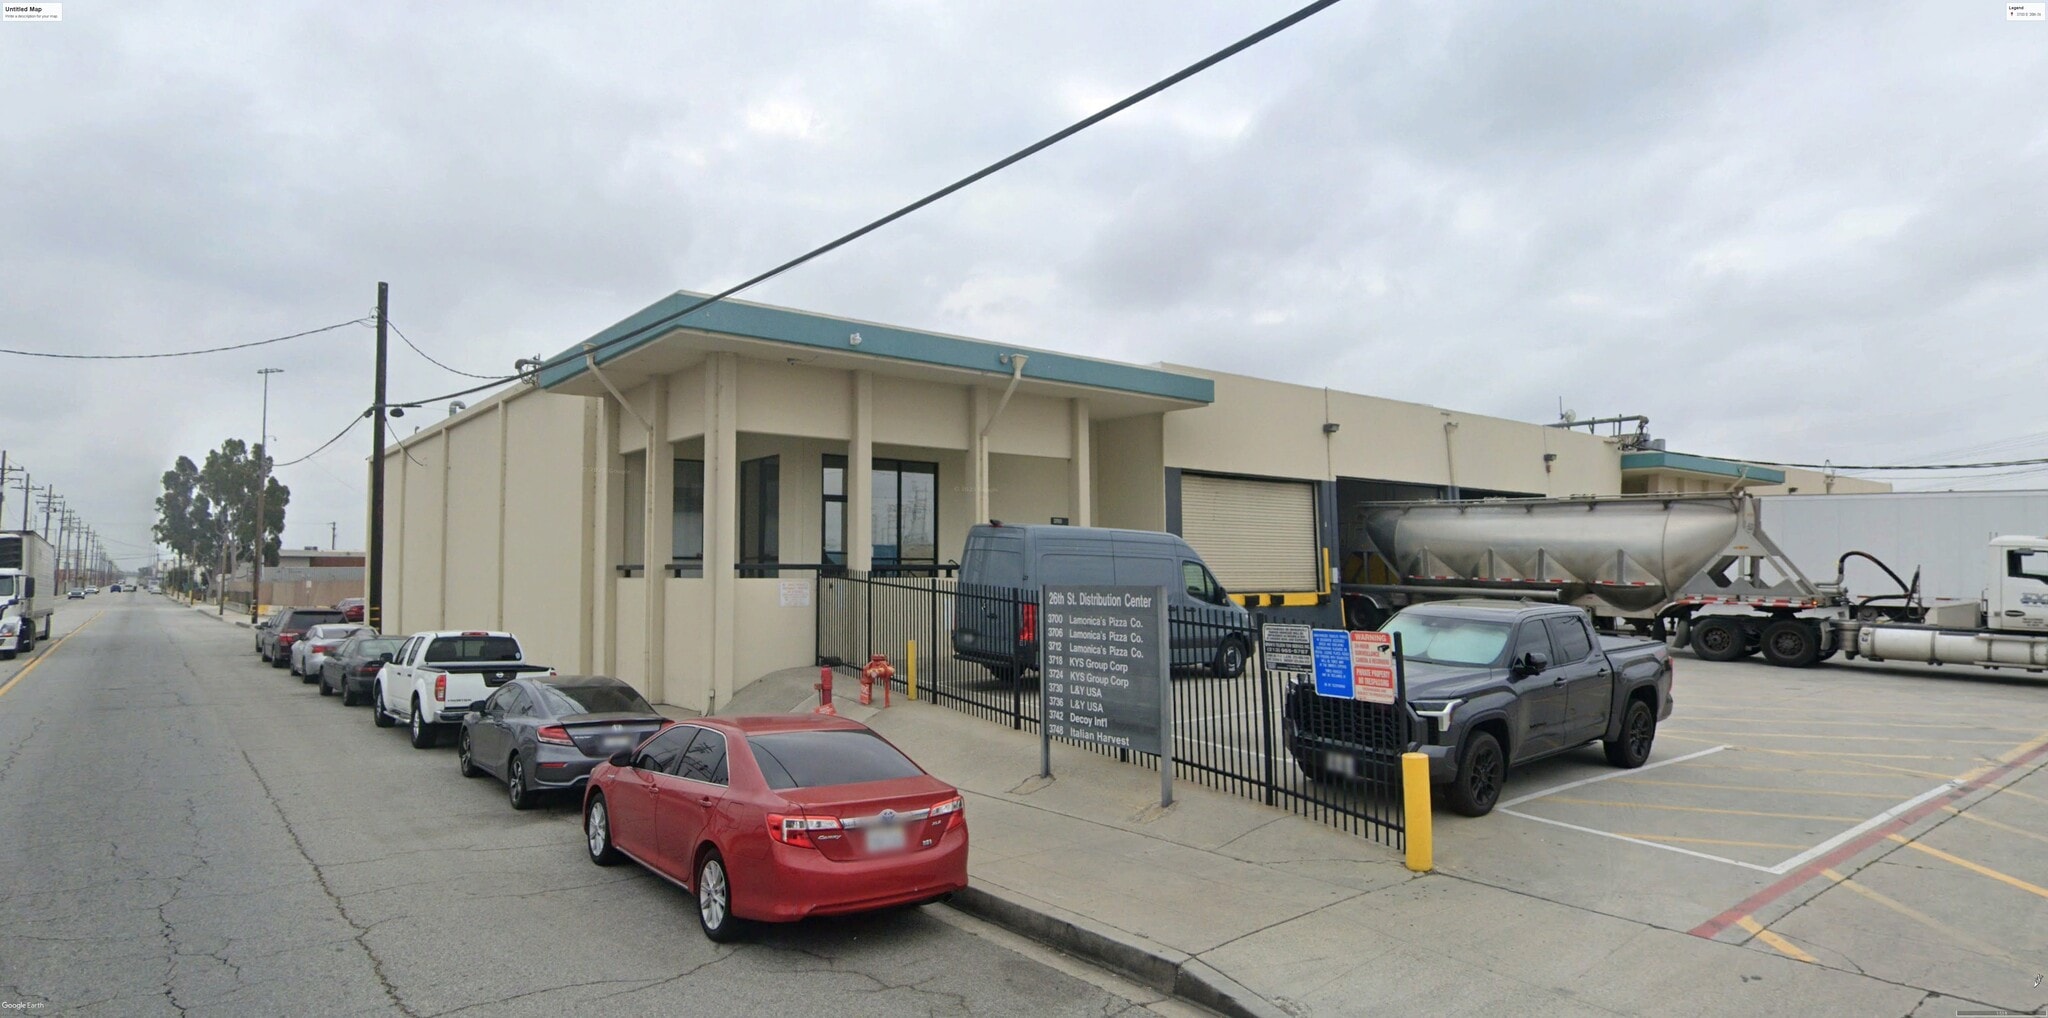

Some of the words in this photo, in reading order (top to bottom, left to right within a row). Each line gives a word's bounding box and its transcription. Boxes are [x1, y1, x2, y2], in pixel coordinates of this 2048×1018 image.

[1048, 592, 1064, 605] 26th
[1067, 592, 1077, 605] St.
[1080, 592, 1121, 607] Distribution
[1124, 594, 1152, 608] Center
[1048, 614, 1063, 624] 3700
[1069, 615, 1106, 626] Lamonica's
[1109, 617, 1127, 627] Pizza
[1130, 618, 1143, 628] Co.
[1048, 628, 1063, 638] 3706
[1069, 629, 1106, 641] Lamonica's
[1109, 631, 1127, 642] Pizza
[1130, 632, 1143, 643] Co.
[1355, 633, 1386, 642] WARNING
[1048, 641, 1062, 651] 3712
[1070, 643, 1107, 655] Lamonica's
[1110, 646, 1128, 657] Pizza
[1131, 647, 1144, 658] Co.
[1048, 655, 1063, 665] 3718
[1069, 657, 1084, 667] KYS
[1086, 658, 1108, 671] Group
[1110, 661, 1128, 674] Corp
[1048, 669, 1063, 679] 3724
[1070, 671, 1085, 681] KYS
[1086, 673, 1109, 686] Group
[1110, 676, 1129, 688] Corp
[1048, 682, 1063, 693] 3730
[1070, 685, 1085, 695] L&Y
[1086, 687, 1102, 698] USA
[1049, 696, 1063, 707] 3736
[1070, 699, 1086, 710] L&Y
[1087, 701, 1104, 713] USA
[1049, 710, 1063, 721] 3742
[1070, 713, 1093, 727] Decoy
[1049, 724, 1063, 735] 3748
[1070, 727, 1094, 740] Italian
[1096, 732, 1129, 746] Harvest
